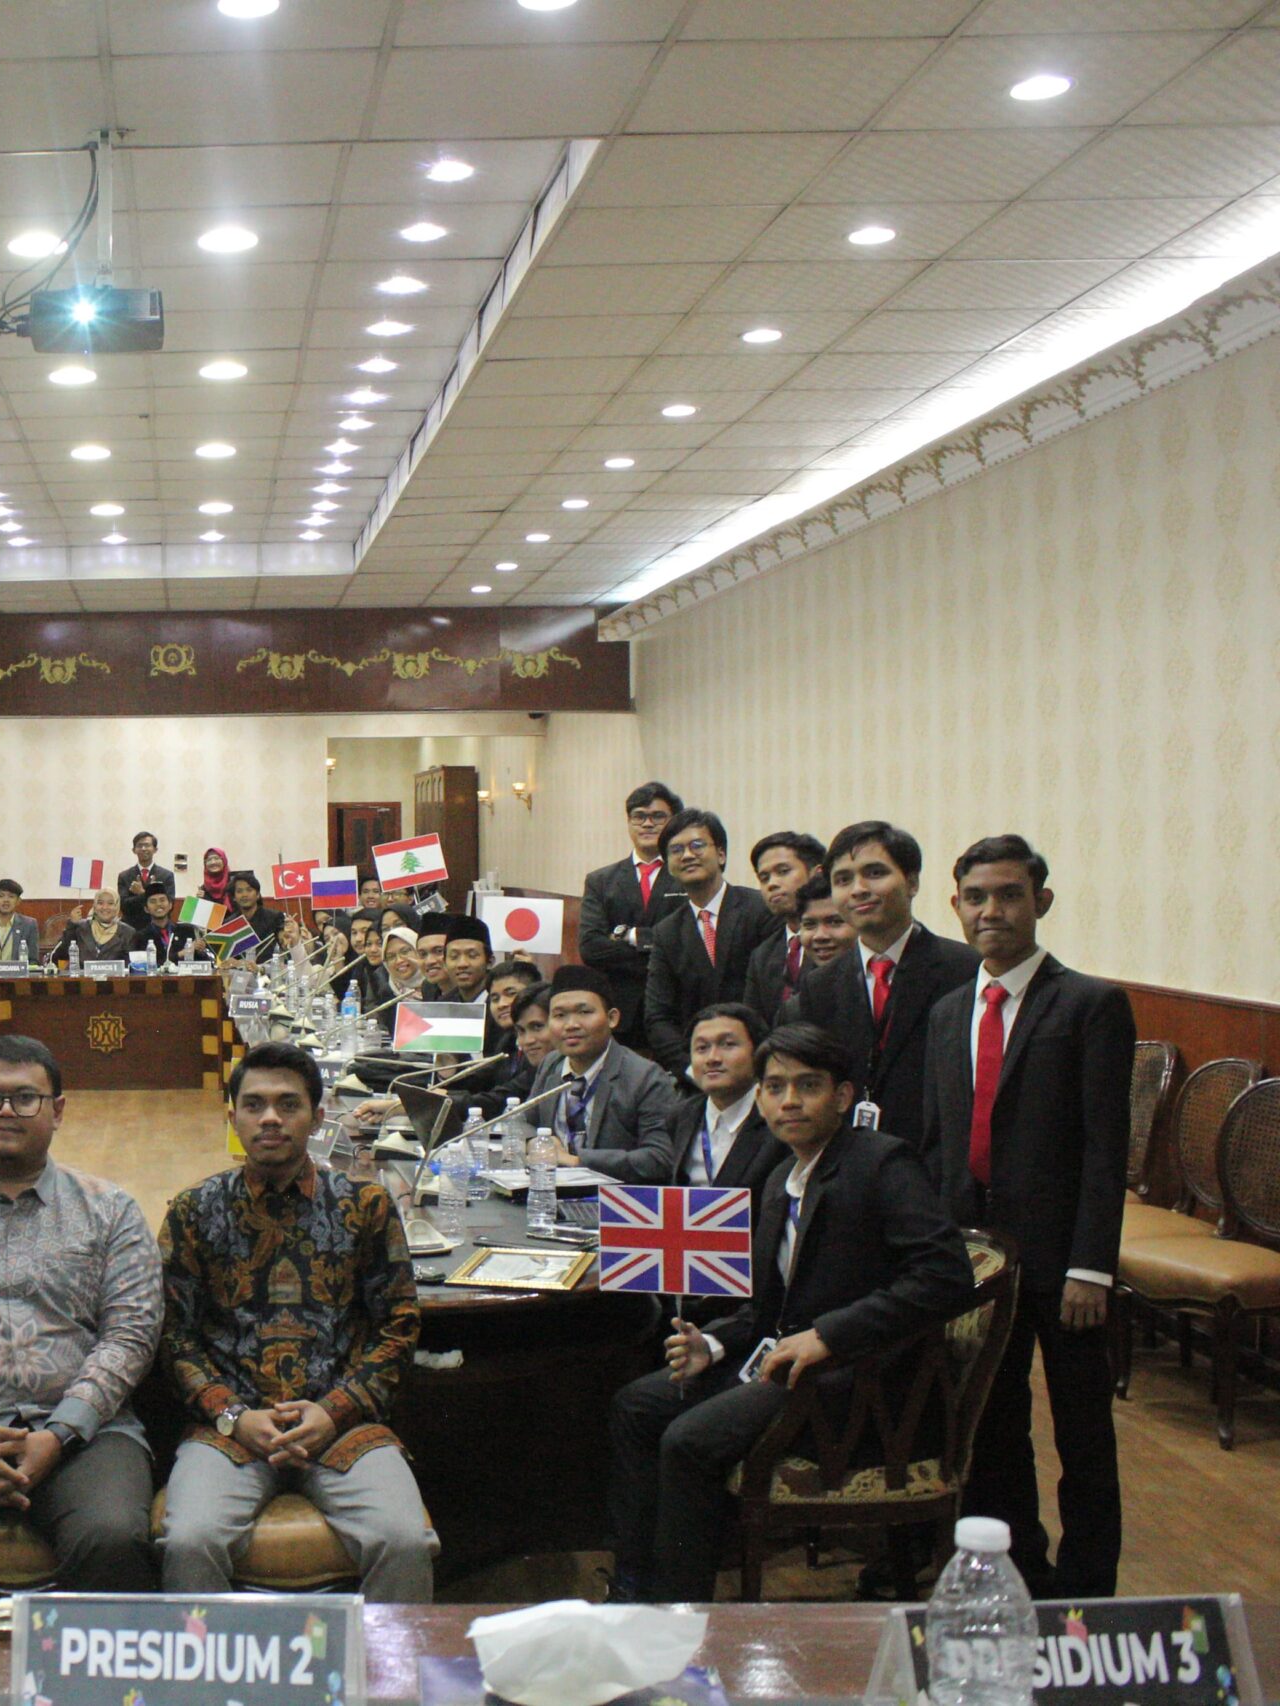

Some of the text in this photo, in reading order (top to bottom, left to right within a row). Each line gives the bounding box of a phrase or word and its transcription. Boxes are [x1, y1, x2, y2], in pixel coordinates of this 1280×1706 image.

[239, 1000, 259, 1009] RUSIA
[60, 1627, 314, 1686] PRESIDIUM 2
[1171, 1630, 1202, 1684] 3
